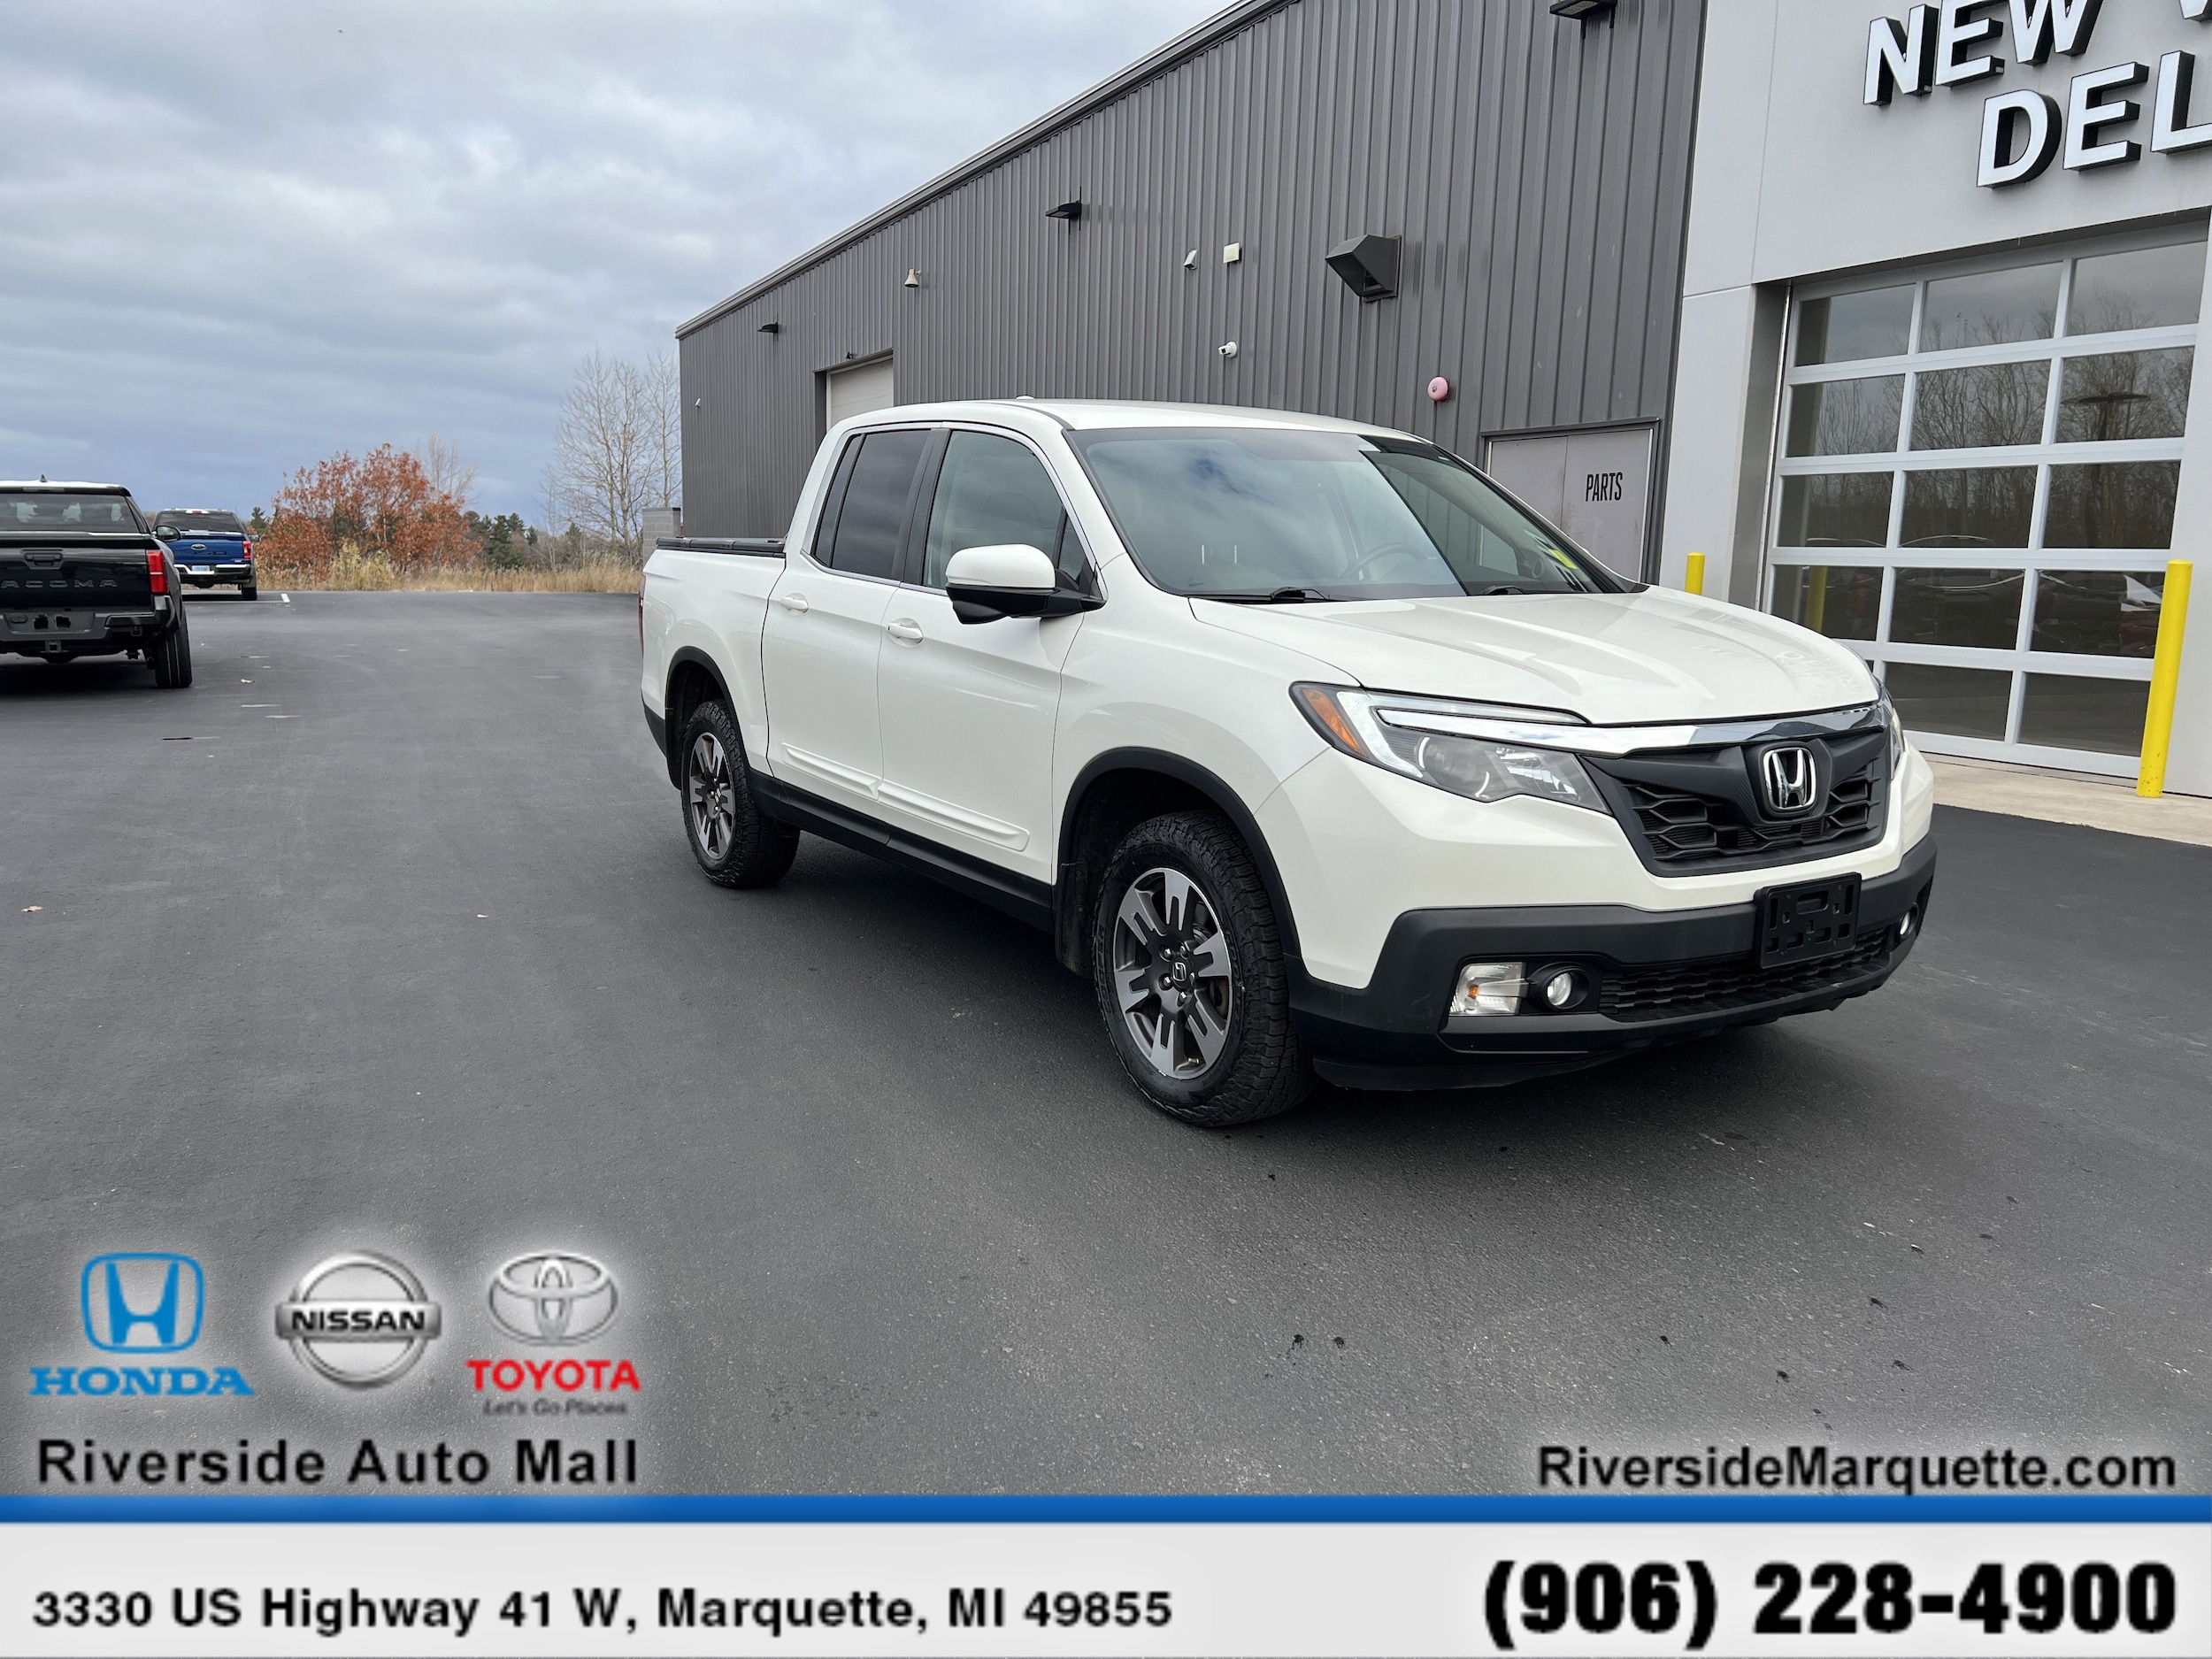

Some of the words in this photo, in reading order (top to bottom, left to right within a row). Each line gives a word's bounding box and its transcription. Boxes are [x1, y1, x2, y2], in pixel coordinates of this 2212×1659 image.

[1863, 0, 2102, 105] NEW
[1977, 50, 2212, 188] DEL
[1585, 472, 1623, 502] PARTS
